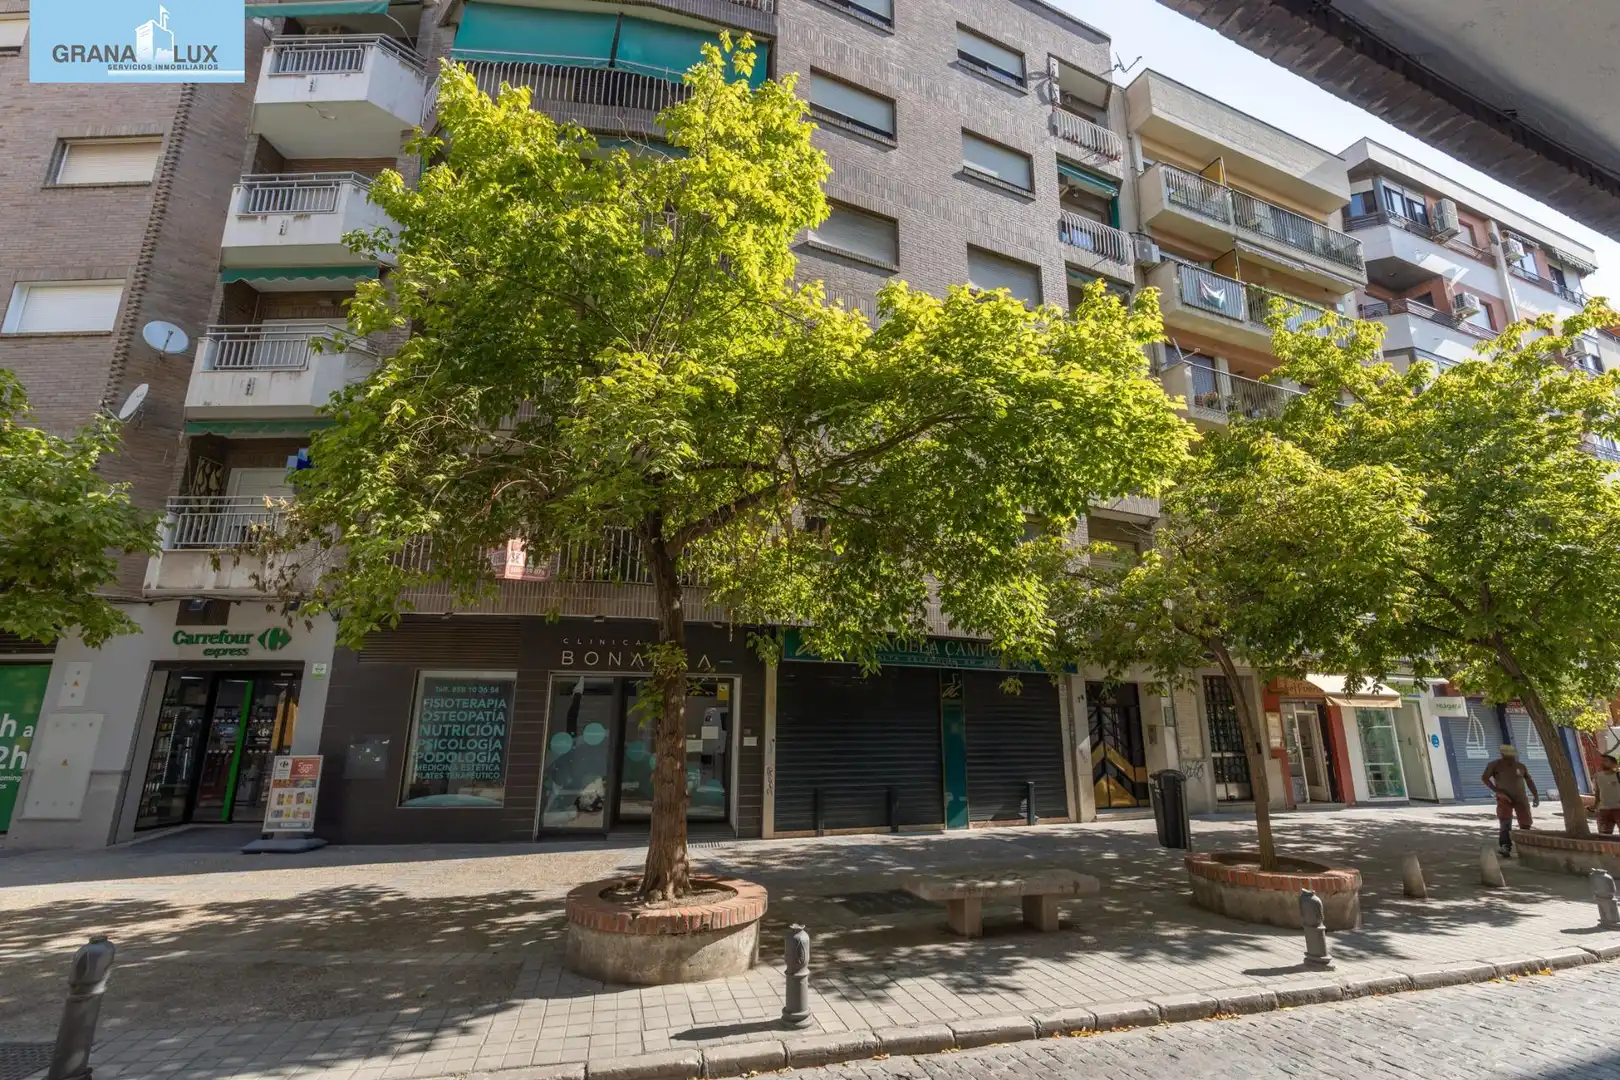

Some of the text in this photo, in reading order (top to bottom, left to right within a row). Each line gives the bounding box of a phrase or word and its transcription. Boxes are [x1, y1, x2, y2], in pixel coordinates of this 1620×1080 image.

[173, 629, 255, 645] Carrefour
[563, 637, 642, 646] CLINICA
[203, 648, 249, 658] express
[423, 697, 508, 709] FISIOTERAPIA
[421, 709, 506, 721] OSTEOPATÍA
[23, 725, 34, 738] a
[419, 721, 506, 737] NUTRICIÓN
[416, 736, 503, 750] PSICOLOGÍA
[416, 749, 502, 763] PODOLOGÍA
